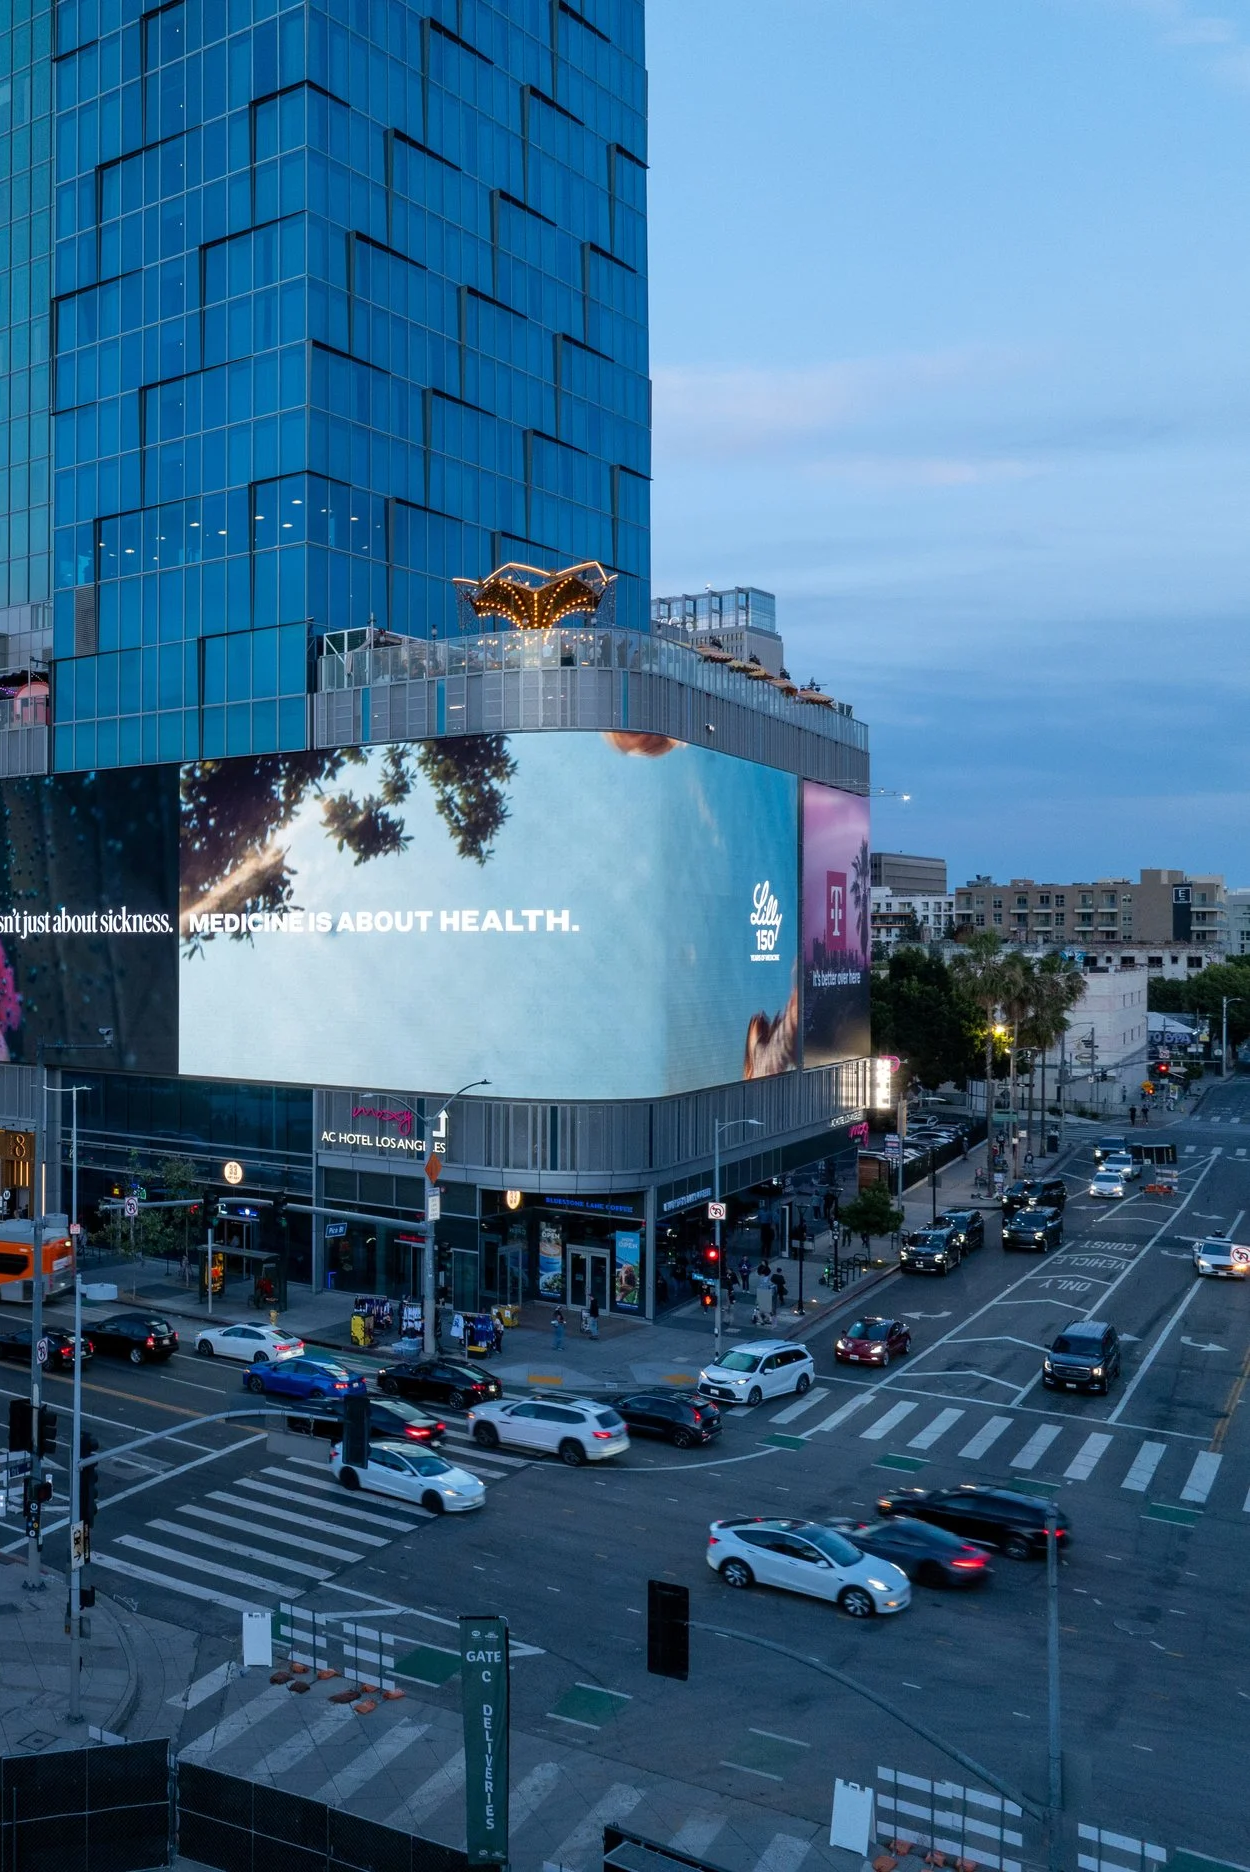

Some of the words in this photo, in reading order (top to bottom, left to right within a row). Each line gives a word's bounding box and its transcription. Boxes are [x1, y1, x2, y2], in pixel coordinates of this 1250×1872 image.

[1178, 889, 1186, 898] E
[750, 880, 782, 941] Lilly
[21, 910, 50, 939] just
[53, 907, 97, 933] about
[100, 906, 173, 933] sickness.
[189, 912, 303, 933] MEDICINE
[308, 911, 332, 933] IS
[337, 910, 433, 933] ABOUT
[440, 909, 579, 932] HEALTH.
[756, 930, 775, 950] 150
[812, 969, 821, 987] It's
[821, 970, 837, 987] better
[838, 972, 848, 986] over
[849, 968, 861, 985] here
[352, 1106, 413, 1136] moxy
[15, 1134, 26, 1158] 8
[321, 1131, 336, 1142] AC
[339, 1132, 373, 1146] HOTEL
[376, 1136, 396, 1149] LOS
[397, 1139, 446, 1153] ANGES
[545, 1196, 584, 1208] BLUESTONE
[585, 1199, 605, 1209] LANE
[605, 1202, 633, 1213] COFFEE
[541, 1231, 560, 1239] OPEN
[618, 1241, 638, 1249] OPEN
[1079, 1240, 1137, 1251] CONST
[1052, 1255, 1128, 1270] VEHICLE
[1038, 1279, 1091, 1292] ONLY
[466, 1650, 502, 1663] GATE
[481, 1670, 492, 1683] C
[482, 1704, 495, 1830] DELIVERIES
